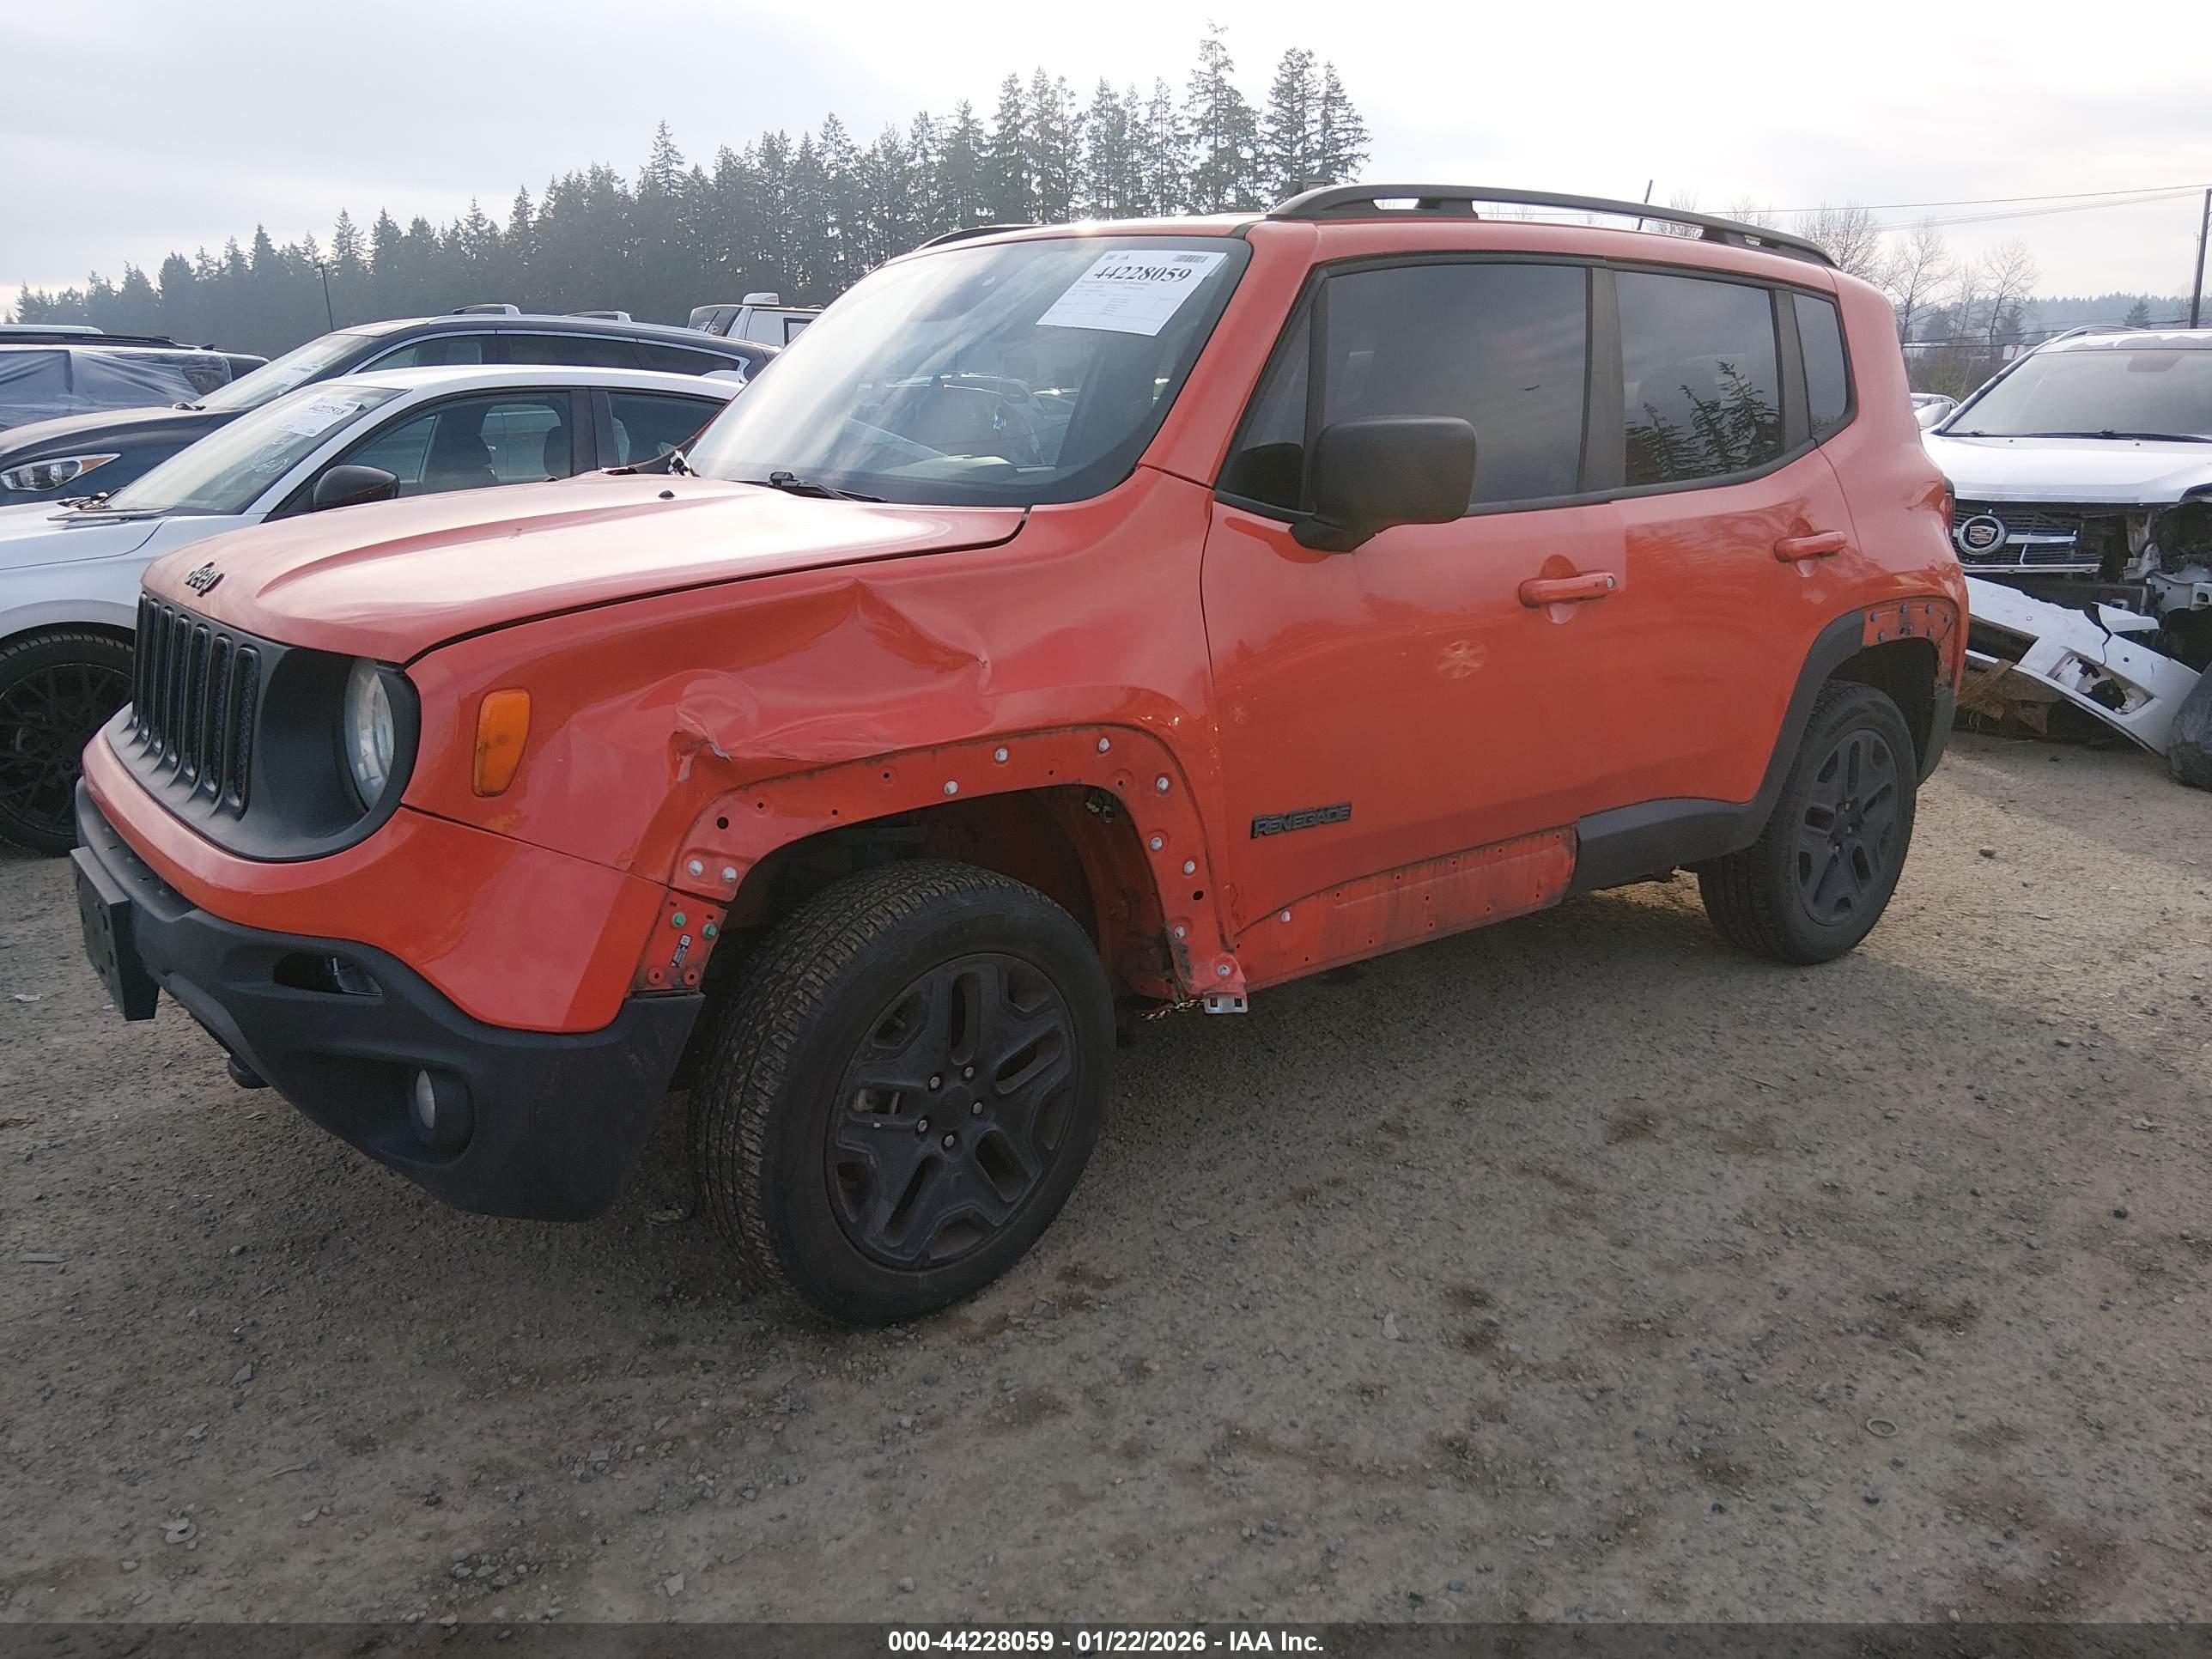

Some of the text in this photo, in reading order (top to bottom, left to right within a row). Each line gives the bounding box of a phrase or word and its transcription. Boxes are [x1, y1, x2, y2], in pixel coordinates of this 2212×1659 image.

[1094, 265, 1193, 283] 44228059
[185, 561, 225, 598] Jeep
[1250, 801, 1352, 839] RENEGADE
